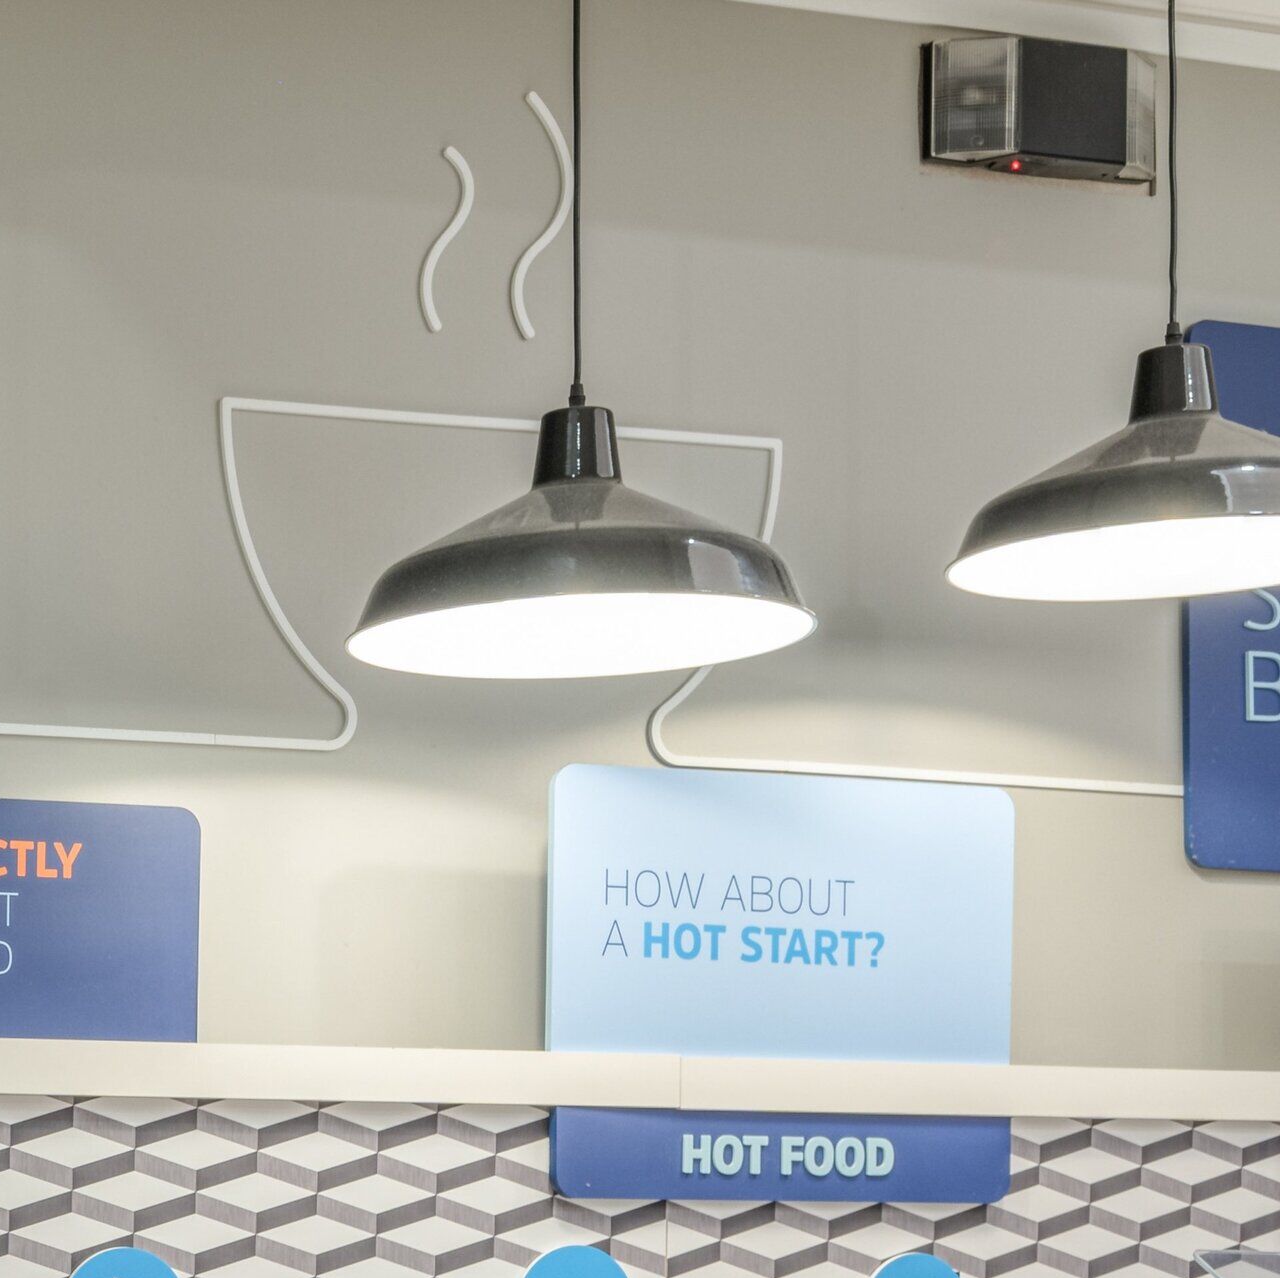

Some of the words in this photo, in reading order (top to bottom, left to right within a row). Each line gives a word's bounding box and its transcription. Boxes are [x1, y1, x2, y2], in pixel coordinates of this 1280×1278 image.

[604, 867, 705, 910] HOW
[720, 874, 856, 917] ABOUT
[601, 919, 629, 958] A
[642, 921, 726, 962] HOT
[740, 925, 886, 968] START?
[681, 1133, 769, 1176] HOT
[780, 1136, 895, 1178] FOOD
